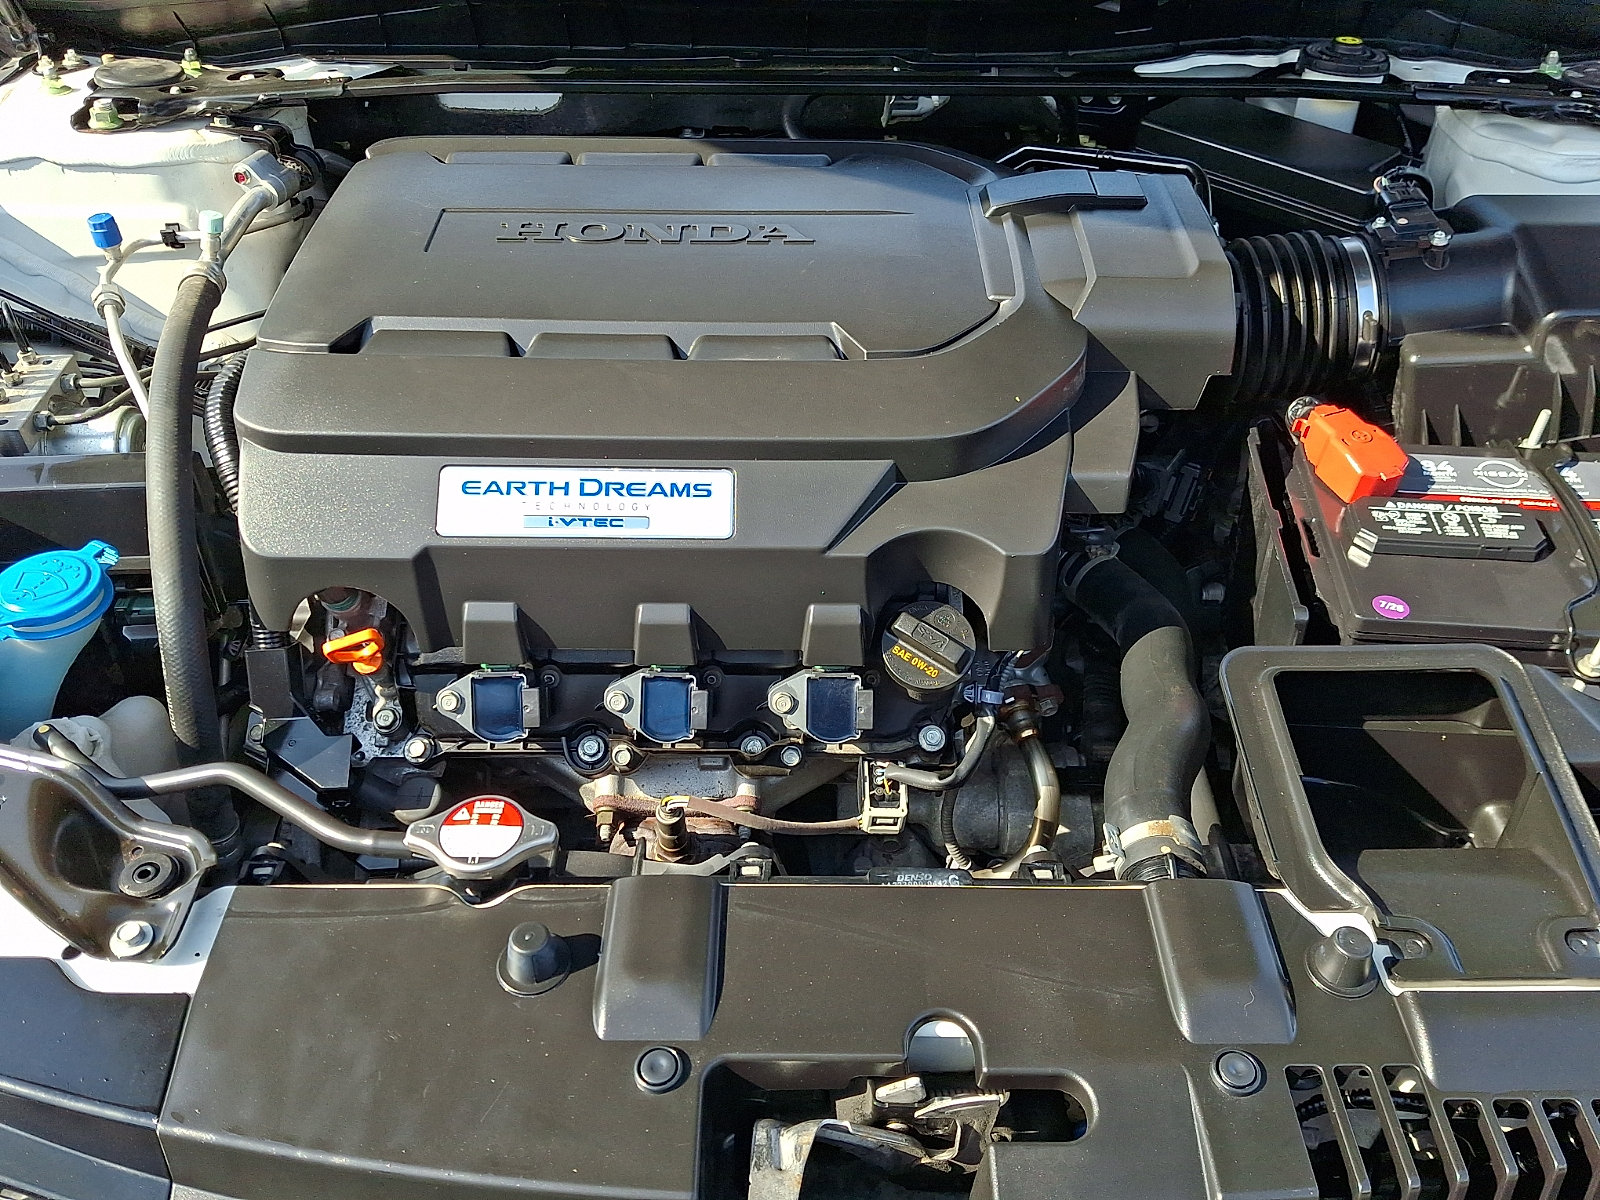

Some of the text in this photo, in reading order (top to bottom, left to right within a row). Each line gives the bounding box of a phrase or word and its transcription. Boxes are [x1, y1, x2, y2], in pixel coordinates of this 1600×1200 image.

[496, 222, 816, 245] HONDA
[1473, 469, 1529, 480] NISSAN
[461, 478, 713, 498] EARTH DREAMS
[891, 645, 940, 679] SAE 0W-20
[896, 873, 933, 882] DENSO
